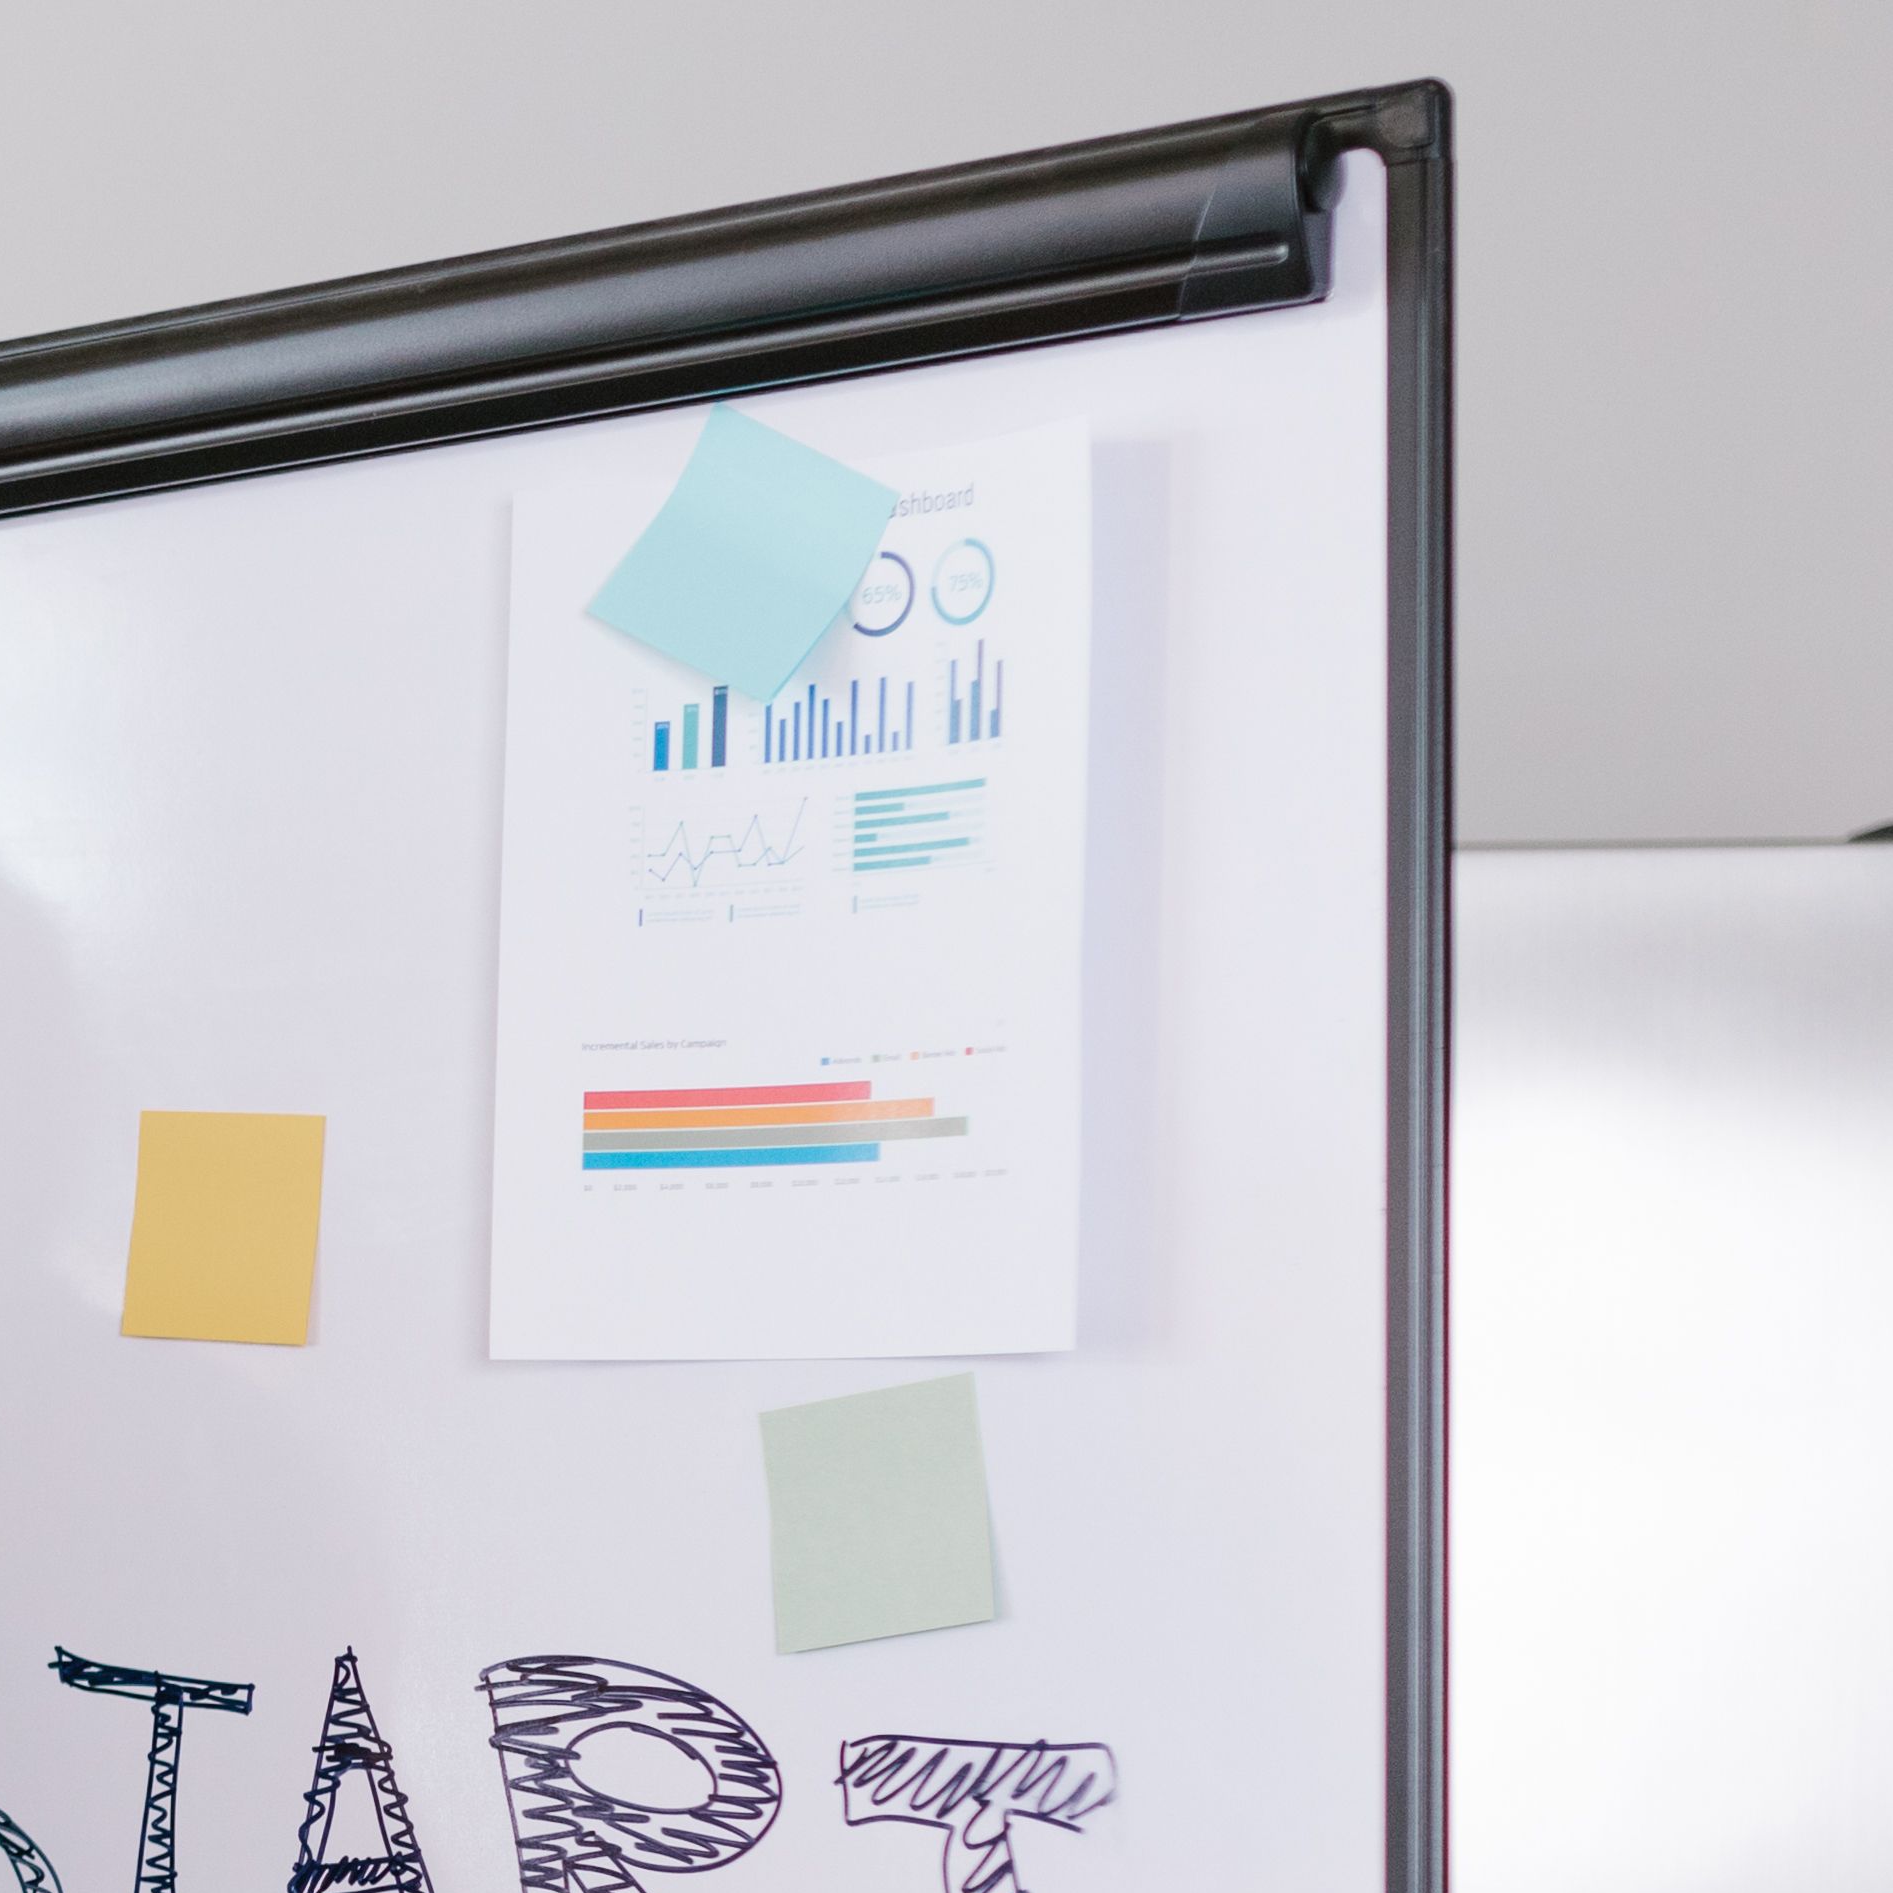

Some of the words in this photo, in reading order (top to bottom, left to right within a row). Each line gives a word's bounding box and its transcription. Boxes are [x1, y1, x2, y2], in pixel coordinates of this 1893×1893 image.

[581, 1041, 638, 1052] Incremental
[640, 1040, 665, 1051] Sales
[666, 1039, 678, 1051] by
[680, 1037, 727, 1050] Campaign
